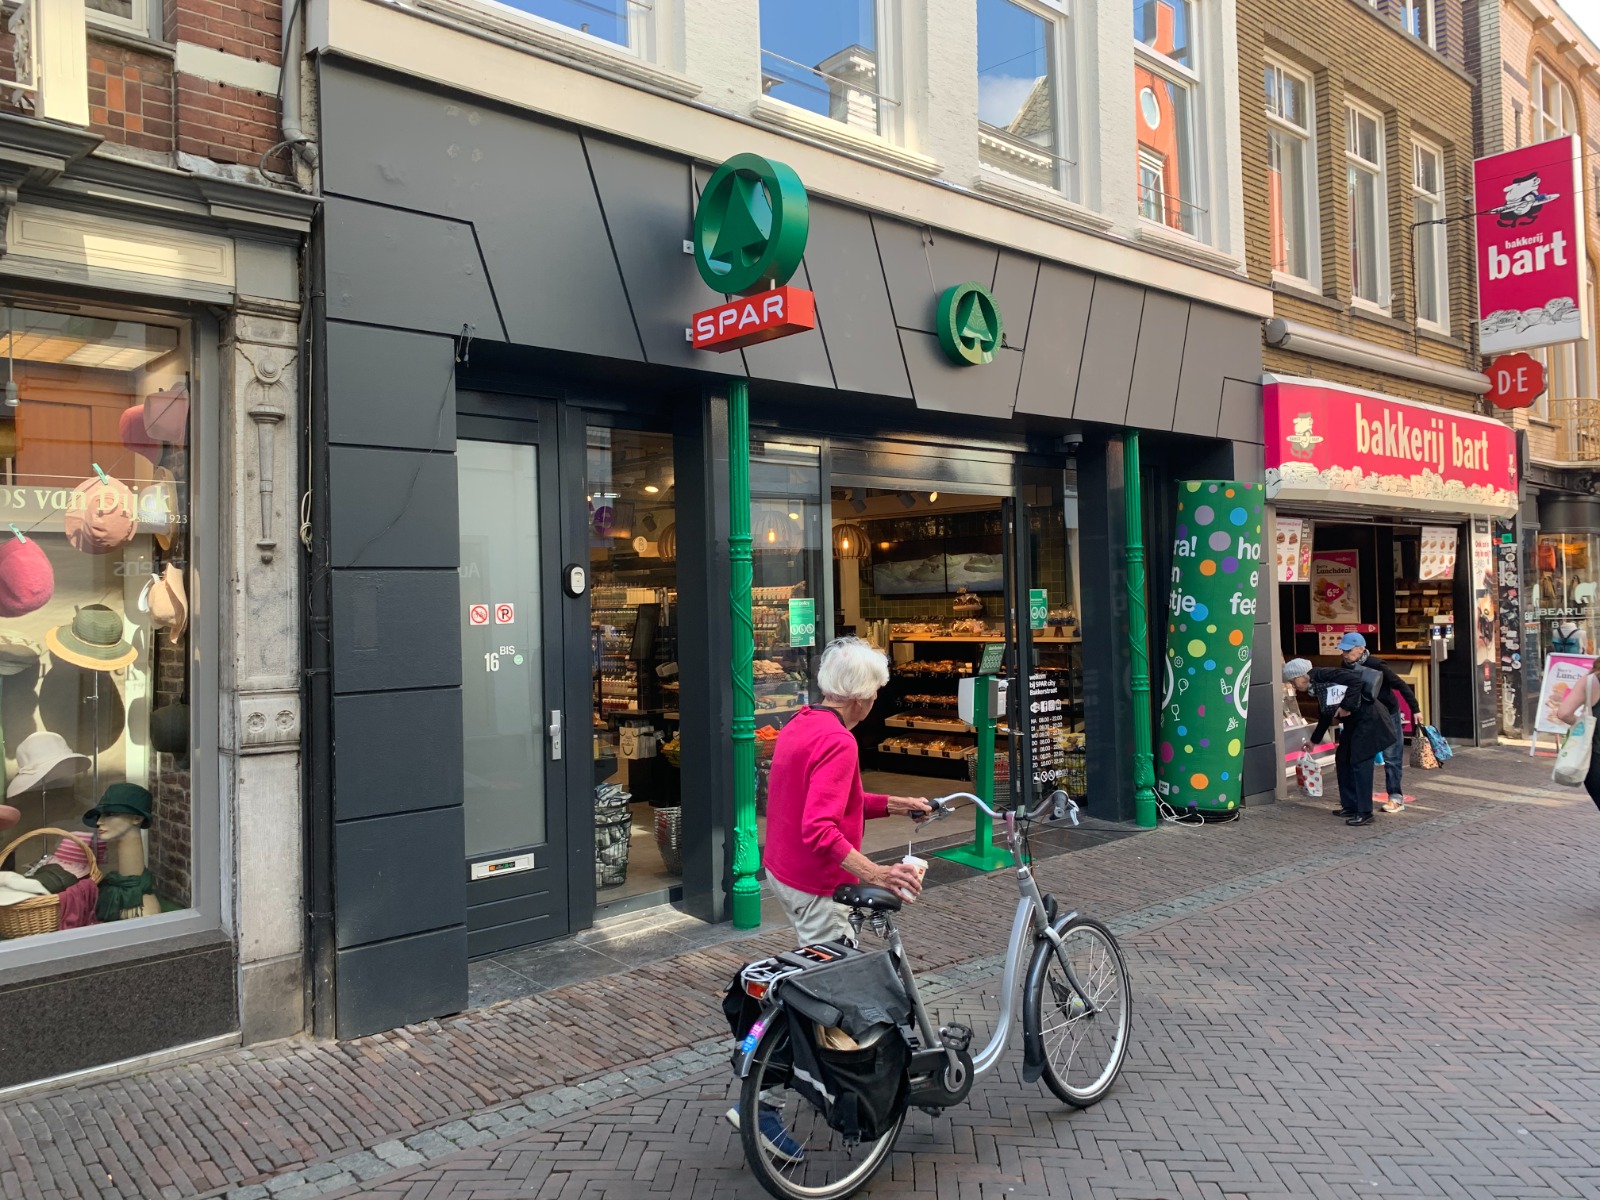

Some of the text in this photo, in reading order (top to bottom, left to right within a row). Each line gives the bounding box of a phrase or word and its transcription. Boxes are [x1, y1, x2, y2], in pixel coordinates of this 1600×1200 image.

[1488, 230, 1567, 281] bart
[1505, 232, 1544, 250] bakkerij
[697, 294, 783, 341] SPAR
[1355, 402, 1489, 474] bakkerij bart
[34, 490, 88, 510] van
[97, 486, 171, 521] Dijck
[163, 514, 188, 524] 1923
[1316, 567, 1352, 575] Lunchdeal
[484, 645, 516, 672] 16 BIS
